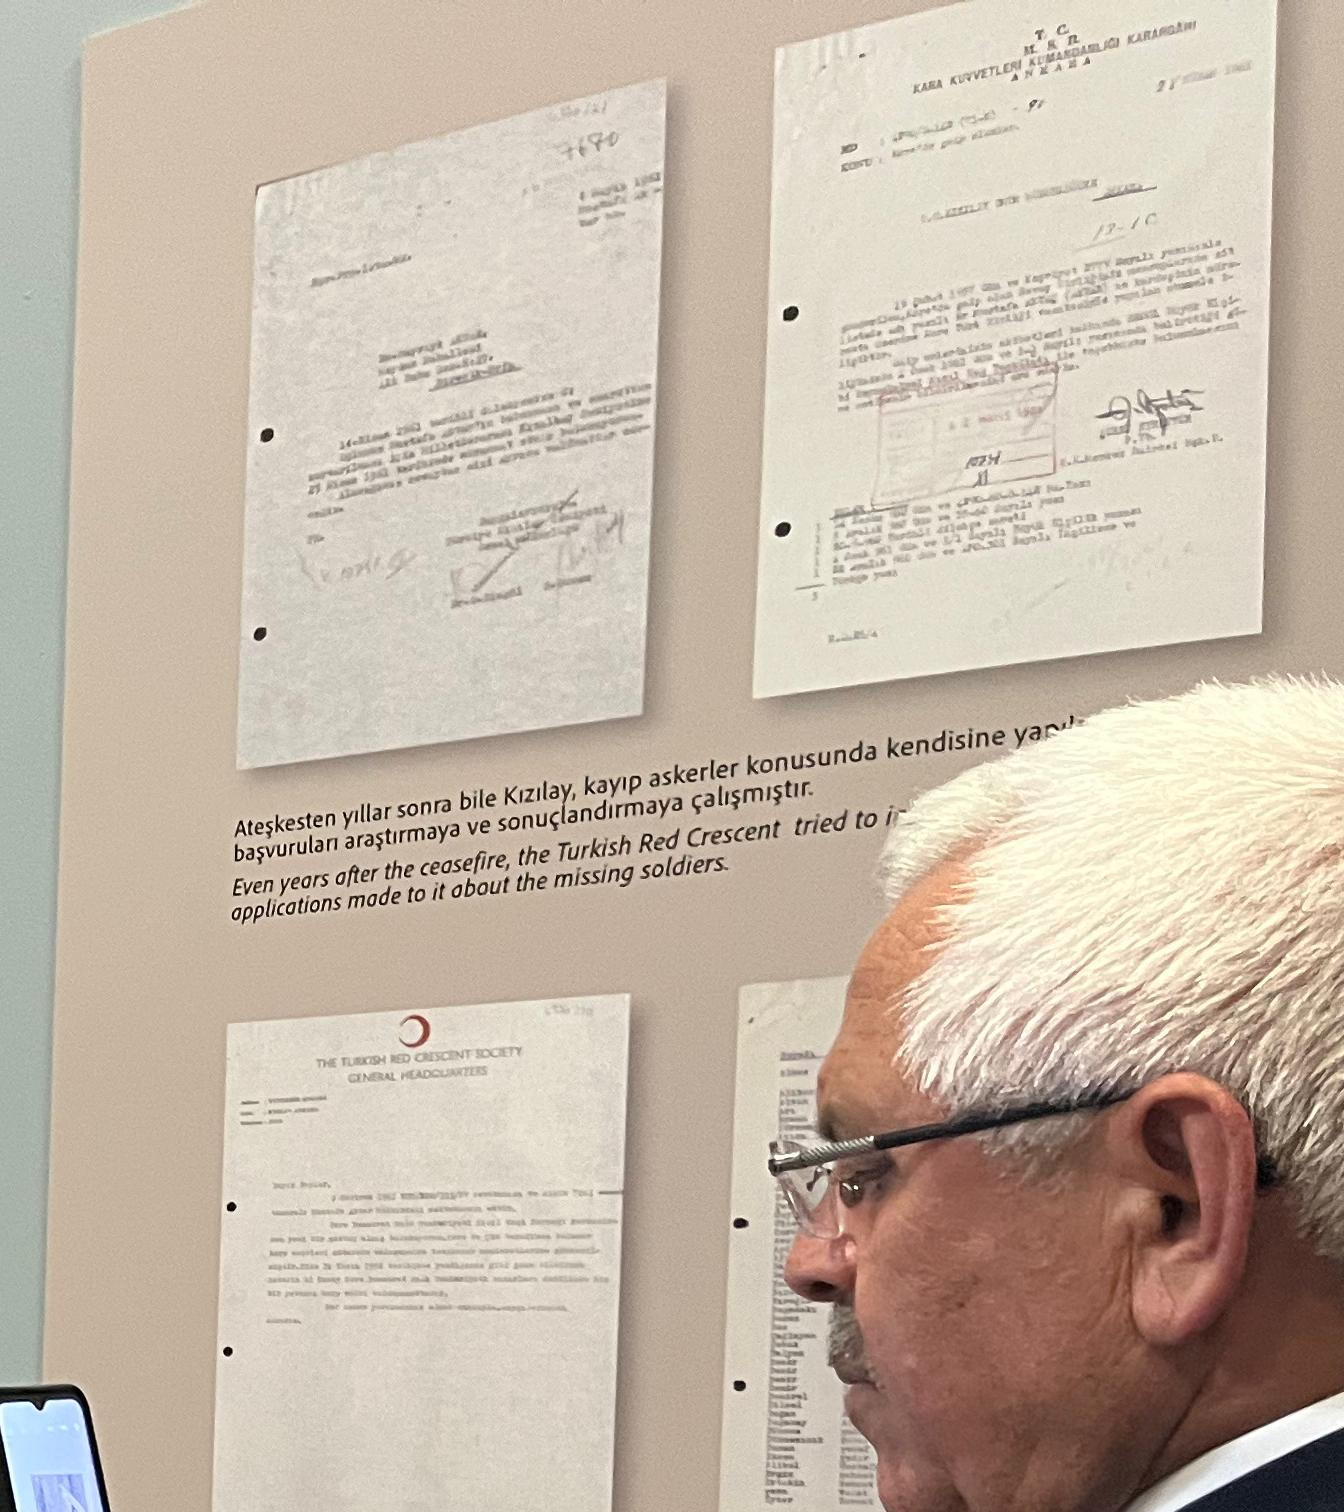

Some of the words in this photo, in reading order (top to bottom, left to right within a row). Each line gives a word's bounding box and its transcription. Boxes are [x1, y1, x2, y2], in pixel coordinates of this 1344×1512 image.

[234, 812, 336, 839] Ateşkesten
[343, 803, 392, 830] yıllar
[398, 799, 452, 819] sonra
[460, 790, 497, 811] bile
[505, 780, 576, 806] Kızılay,
[585, 775, 642, 798] kayıp
[649, 759, 739, 788] askerler
[747, 740, 877, 776] konusunda
[887, 728, 1005, 759] kendisine
[232, 877, 273, 896] Even
[280, 872, 329, 897] years
[335, 864, 380, 888] after
[385, 860, 414, 880] the
[420, 849, 510, 877] ceasefire,
[519, 845, 550, 866] the
[558, 834, 632, 862] Turkish
[640, 828, 680, 853] Red
[687, 820, 781, 848] Crescent
[795, 809, 848, 836] tried
[856, 810, 878, 830] to
[234, 835, 338, 864] başvuruları
[345, 823, 460, 851] araştırmaya
[468, 819, 491, 835] ve
[498, 796, 683, 832] sonuçlandırmaya
[692, 780, 814, 815] çalışmıştır.
[231, 896, 341, 924] applications
[348, 886, 402, 909] made
[408, 887, 426, 903] to
[432, 882, 446, 901] it
[451, 876, 510, 898] about
[516, 873, 548, 892] the
[554, 865, 634, 889] missing
[640, 855, 729, 880] soldiers.
[317, 1058, 337, 1068] THE
[391, 1054, 411, 1065] RED
[476, 1046, 523, 1059] SOCIETY
[348, 1073, 396, 1083] GENERAL
